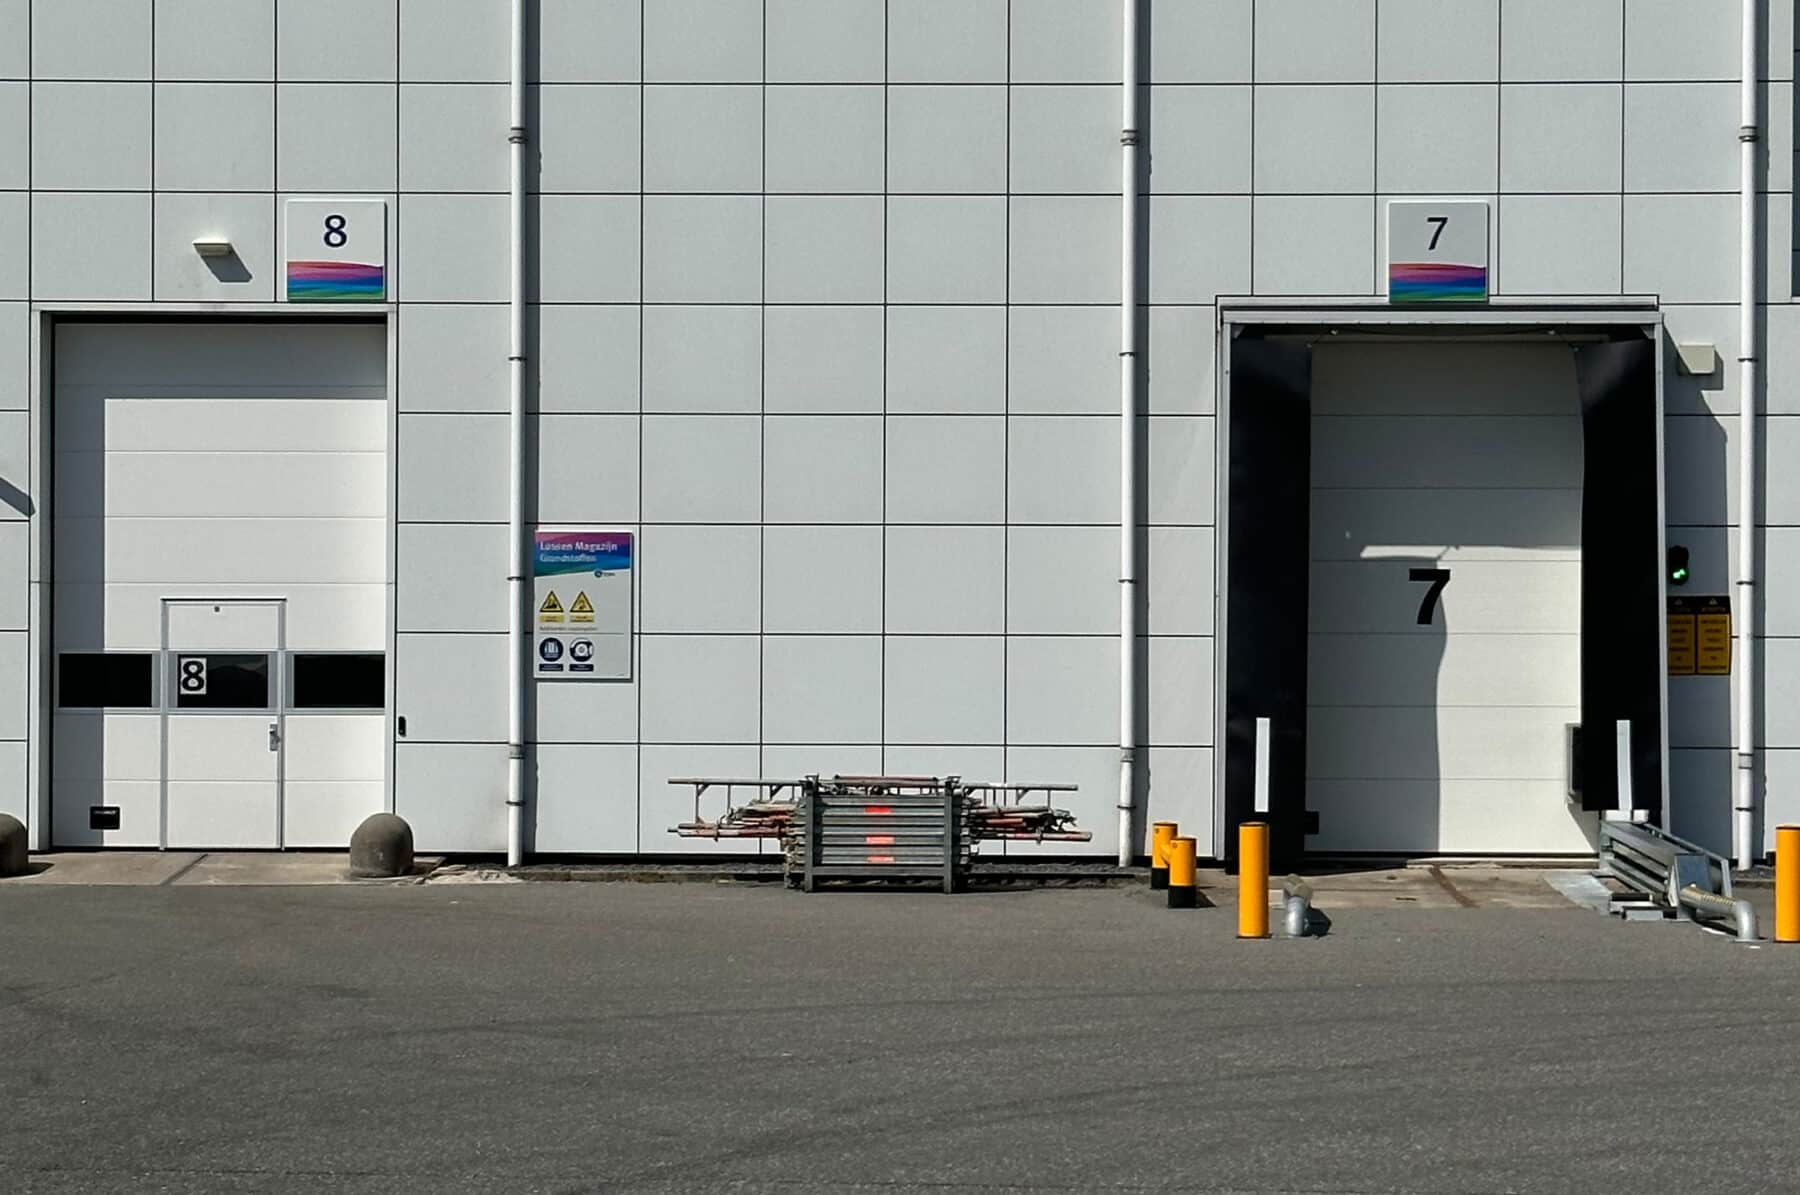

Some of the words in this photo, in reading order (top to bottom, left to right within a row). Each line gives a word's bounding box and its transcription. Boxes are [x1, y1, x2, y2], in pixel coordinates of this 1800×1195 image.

[324, 214, 347, 248] 8
[1427, 216, 1449, 251] 7
[575, 541, 618, 552] Magazijn
[1409, 568, 1451, 625] 7
[182, 660, 205, 692] 8
